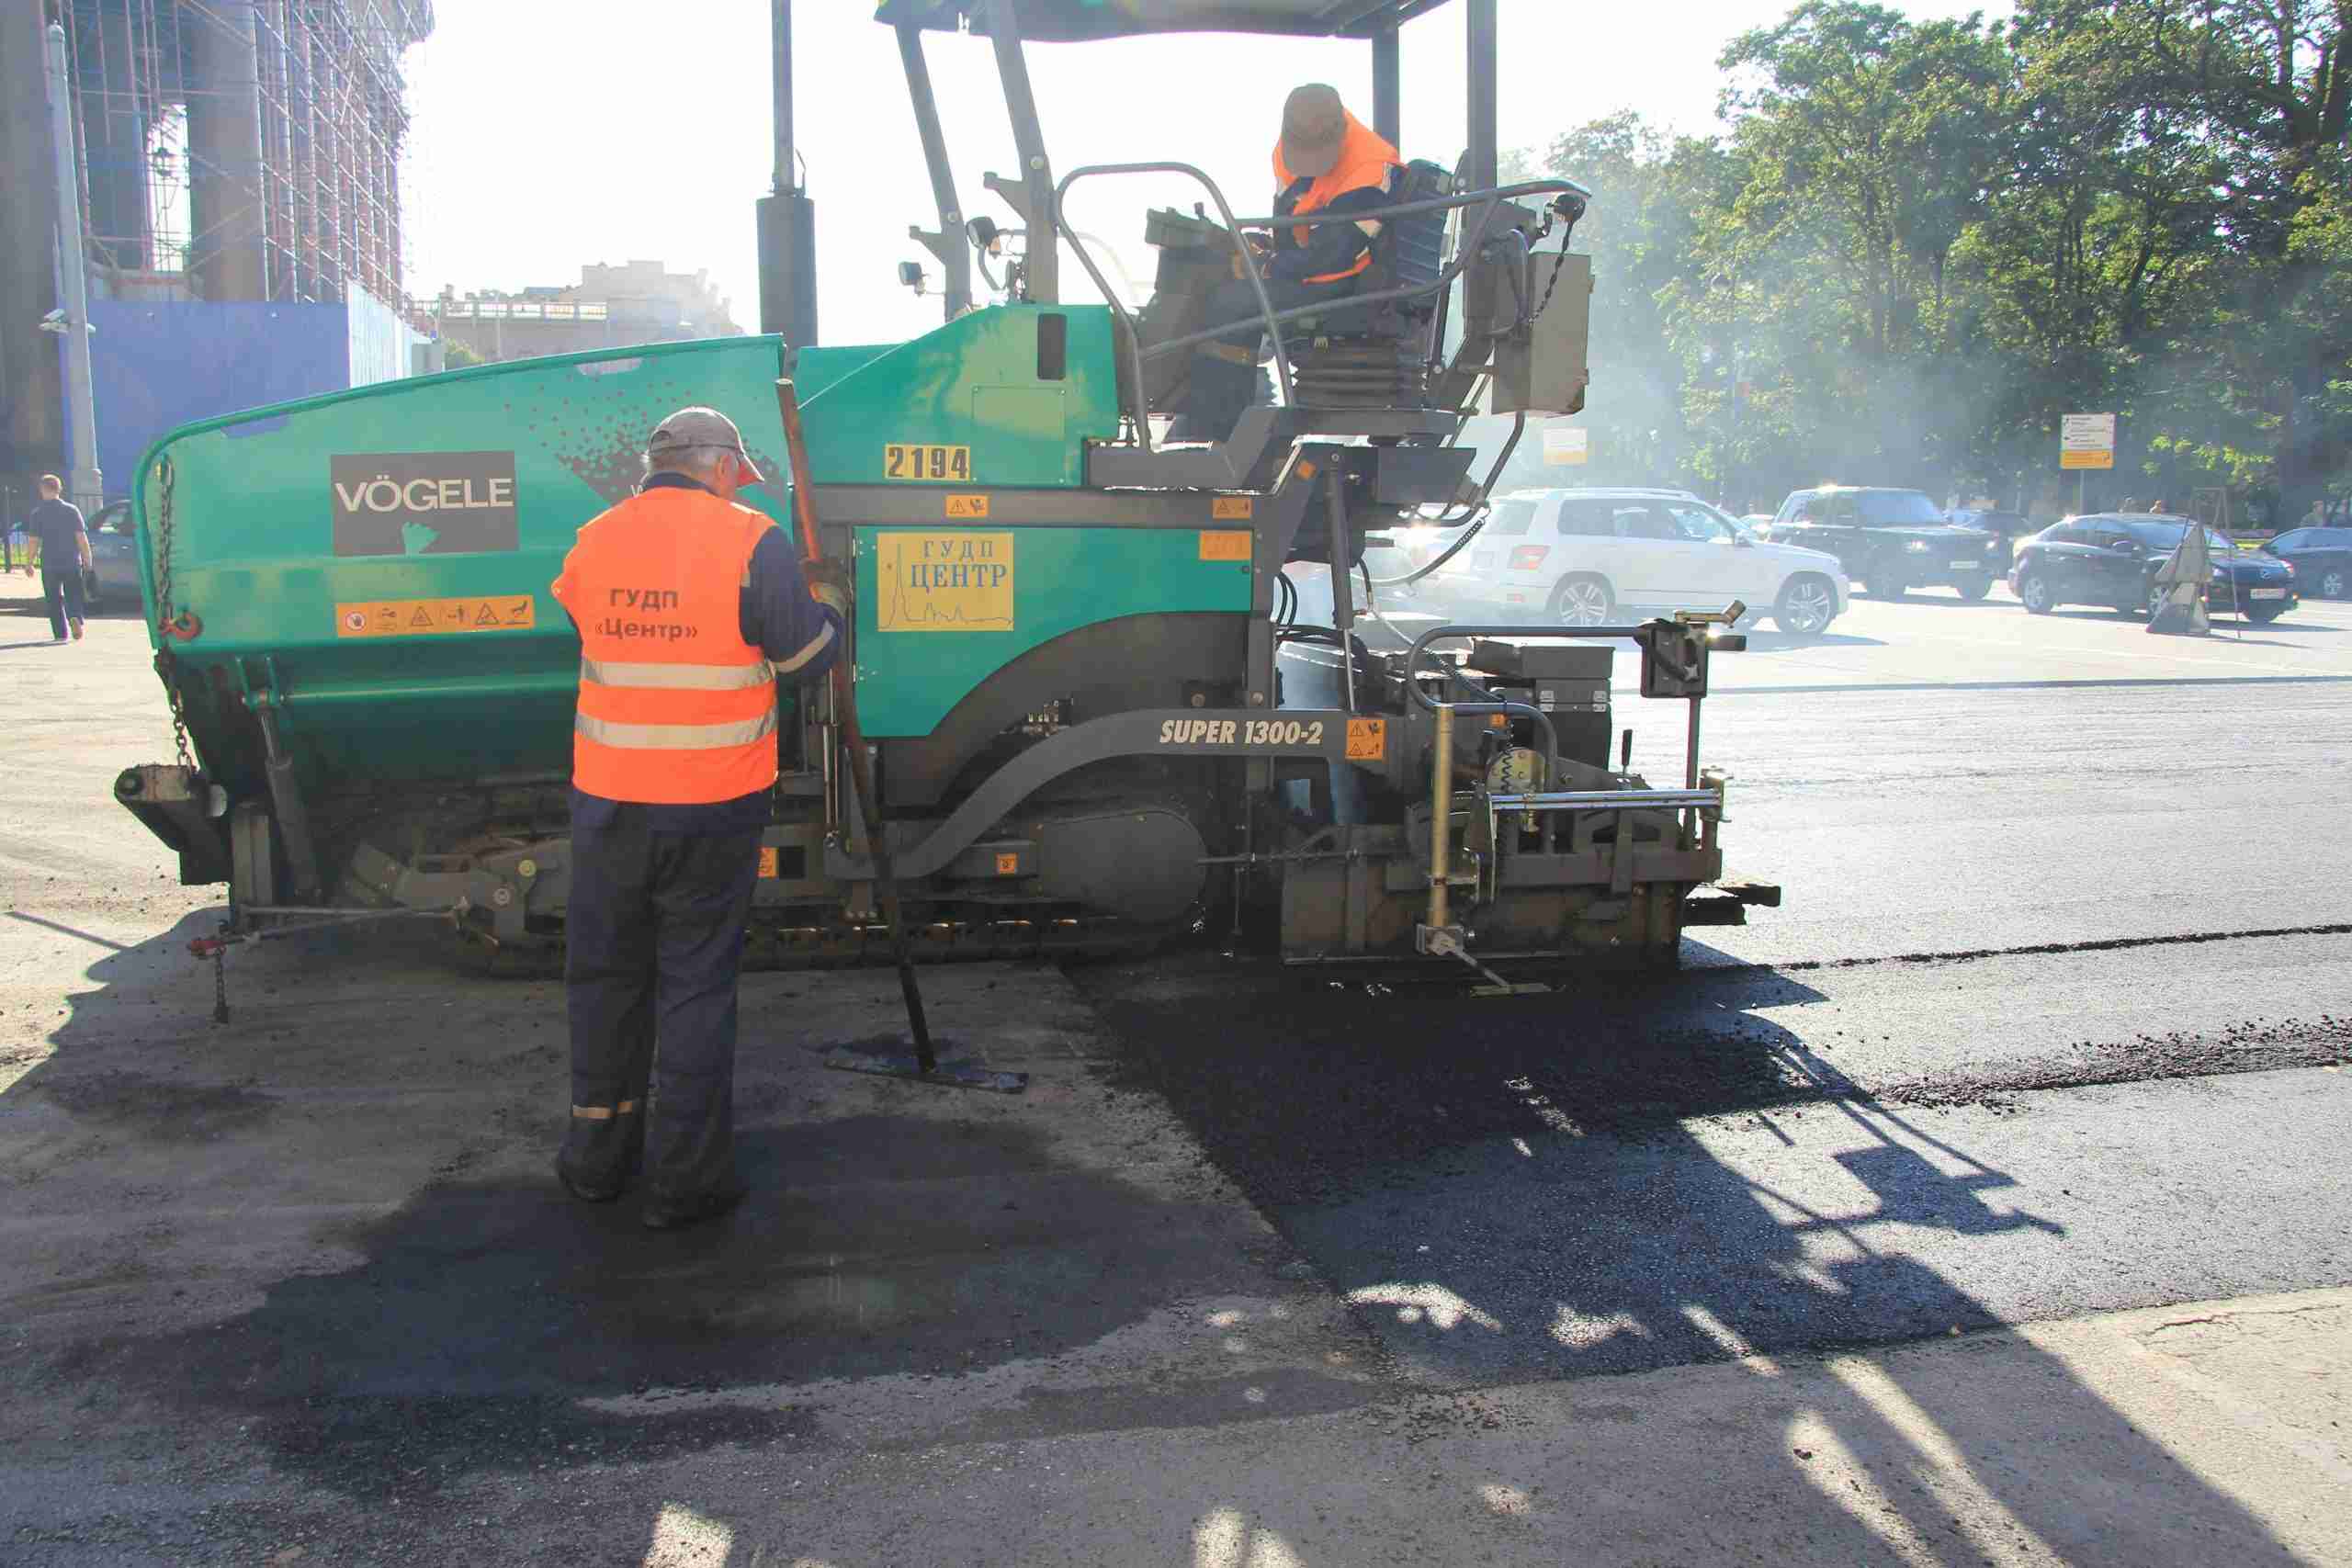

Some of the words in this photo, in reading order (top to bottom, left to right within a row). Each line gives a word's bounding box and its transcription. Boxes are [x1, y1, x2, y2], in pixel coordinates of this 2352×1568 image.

[888, 446, 967, 479] 2194
[334, 474, 514, 512] VÖGELE
[923, 540, 993, 560] ГУДП
[910, 564, 1007, 593] ЦЕНТР
[610, 589, 677, 612] ГУДП
[594, 618, 697, 642] «Центр»
[1159, 719, 1237, 743] SUPER
[1244, 721, 1324, 745] 1300-2
